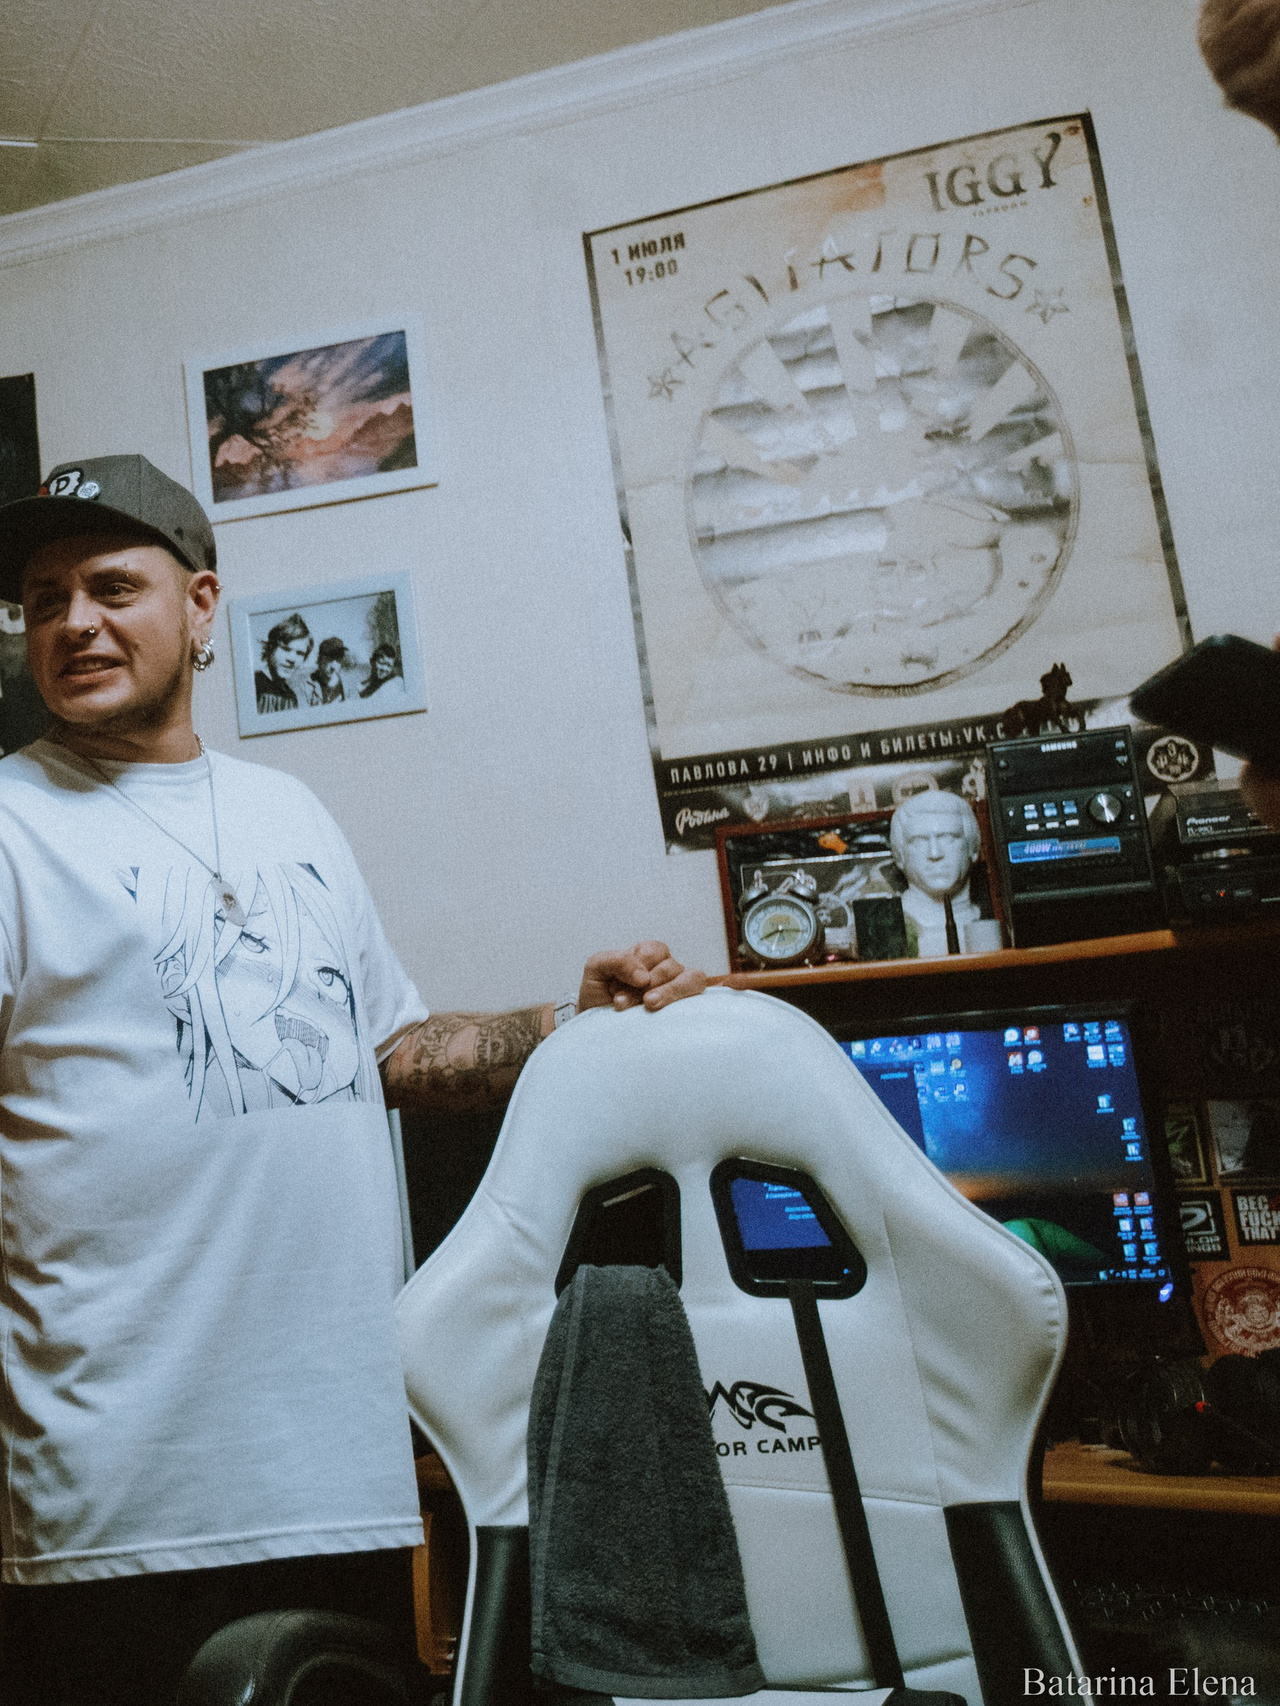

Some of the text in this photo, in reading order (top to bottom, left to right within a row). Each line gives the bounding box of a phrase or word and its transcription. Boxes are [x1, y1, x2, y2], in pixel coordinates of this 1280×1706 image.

[923, 131, 1062, 213] IGGY
[610, 231, 686, 265] 1 ИЮЛЯ
[624, 258, 678, 286] 19:00
[670, 758, 749, 784] ПАВЛОВА
[758, 753, 777, 772] 29
[802, 743, 851, 767] ИНФО
[861, 742, 872, 758] И
[1041, 740, 1078, 753] SAMSUNG
